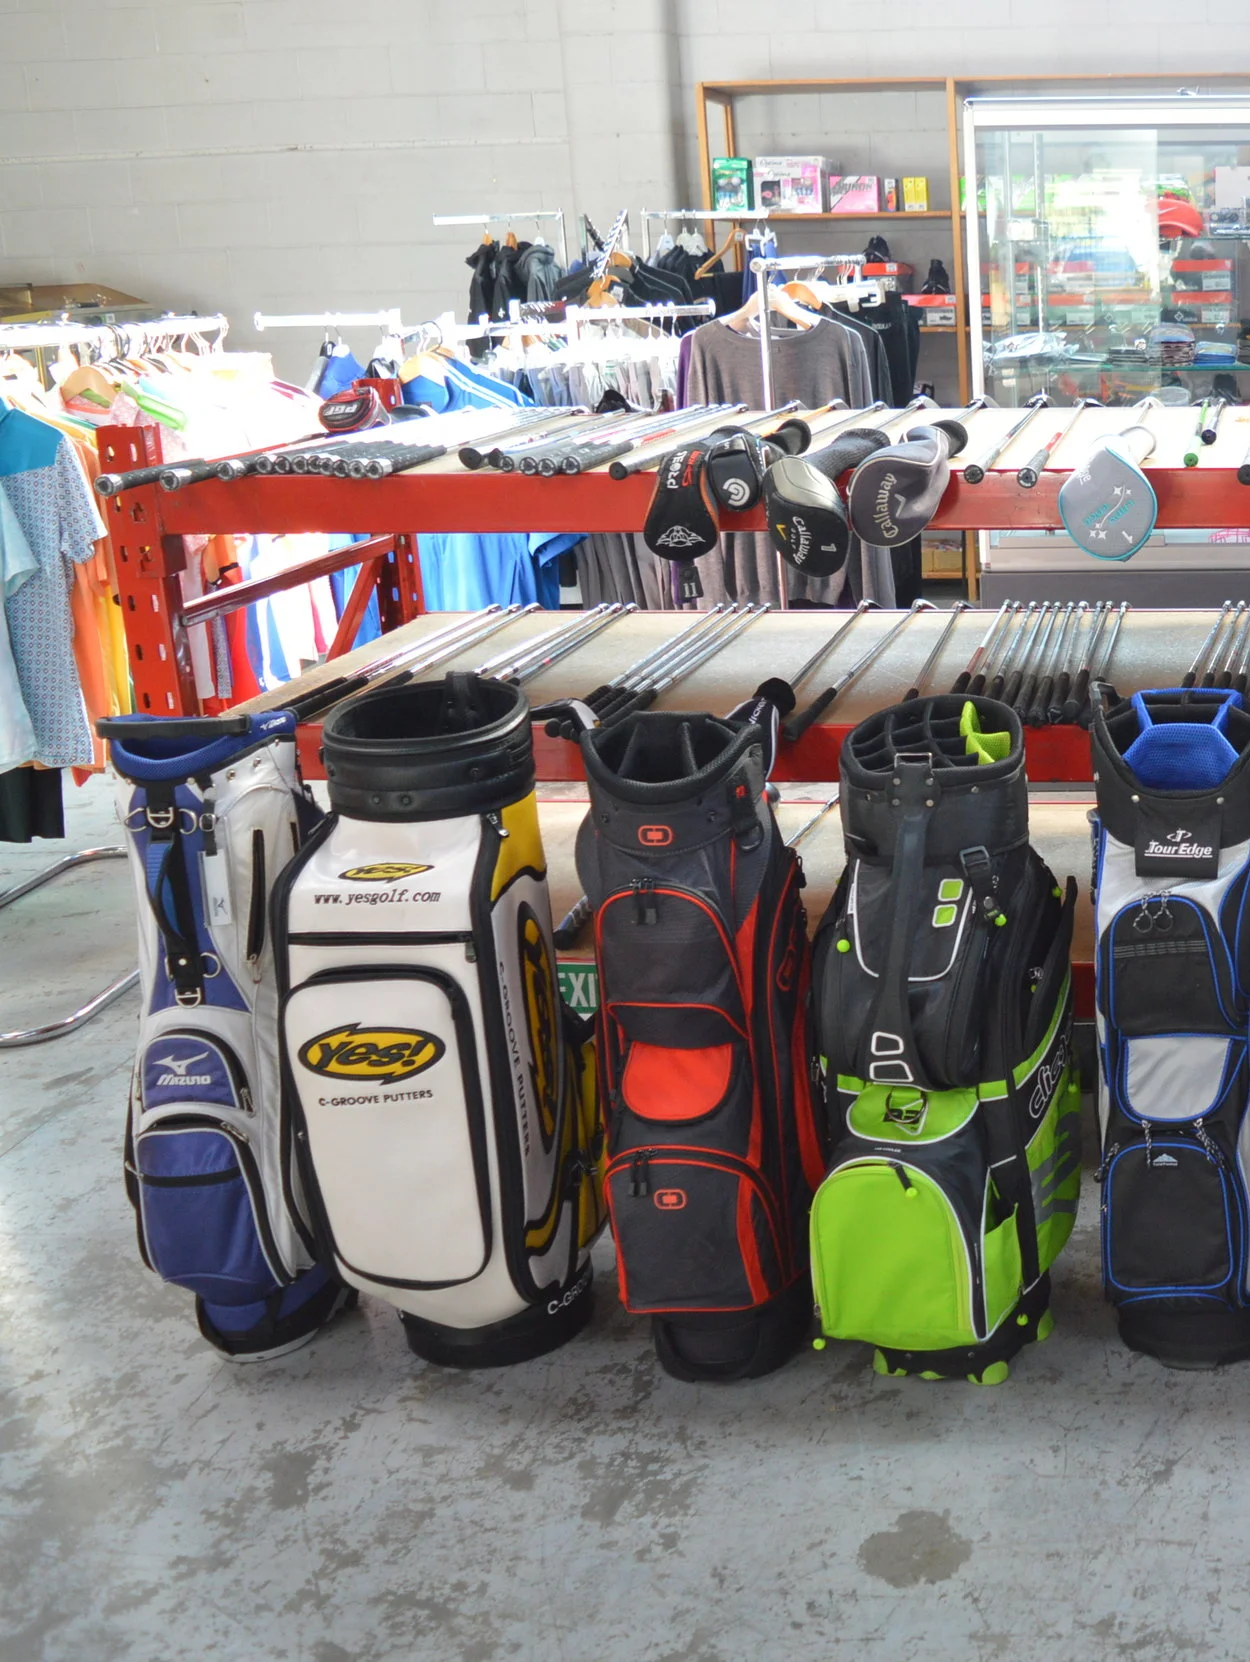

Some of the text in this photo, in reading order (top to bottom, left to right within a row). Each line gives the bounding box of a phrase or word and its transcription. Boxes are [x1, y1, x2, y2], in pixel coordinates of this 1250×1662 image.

[871, 472, 899, 539] Callaway
[791, 515, 812, 565] Callaway
[557, 972, 599, 1008] XI
[318, 1088, 434, 1107] C-GROOVE PUTTERS
